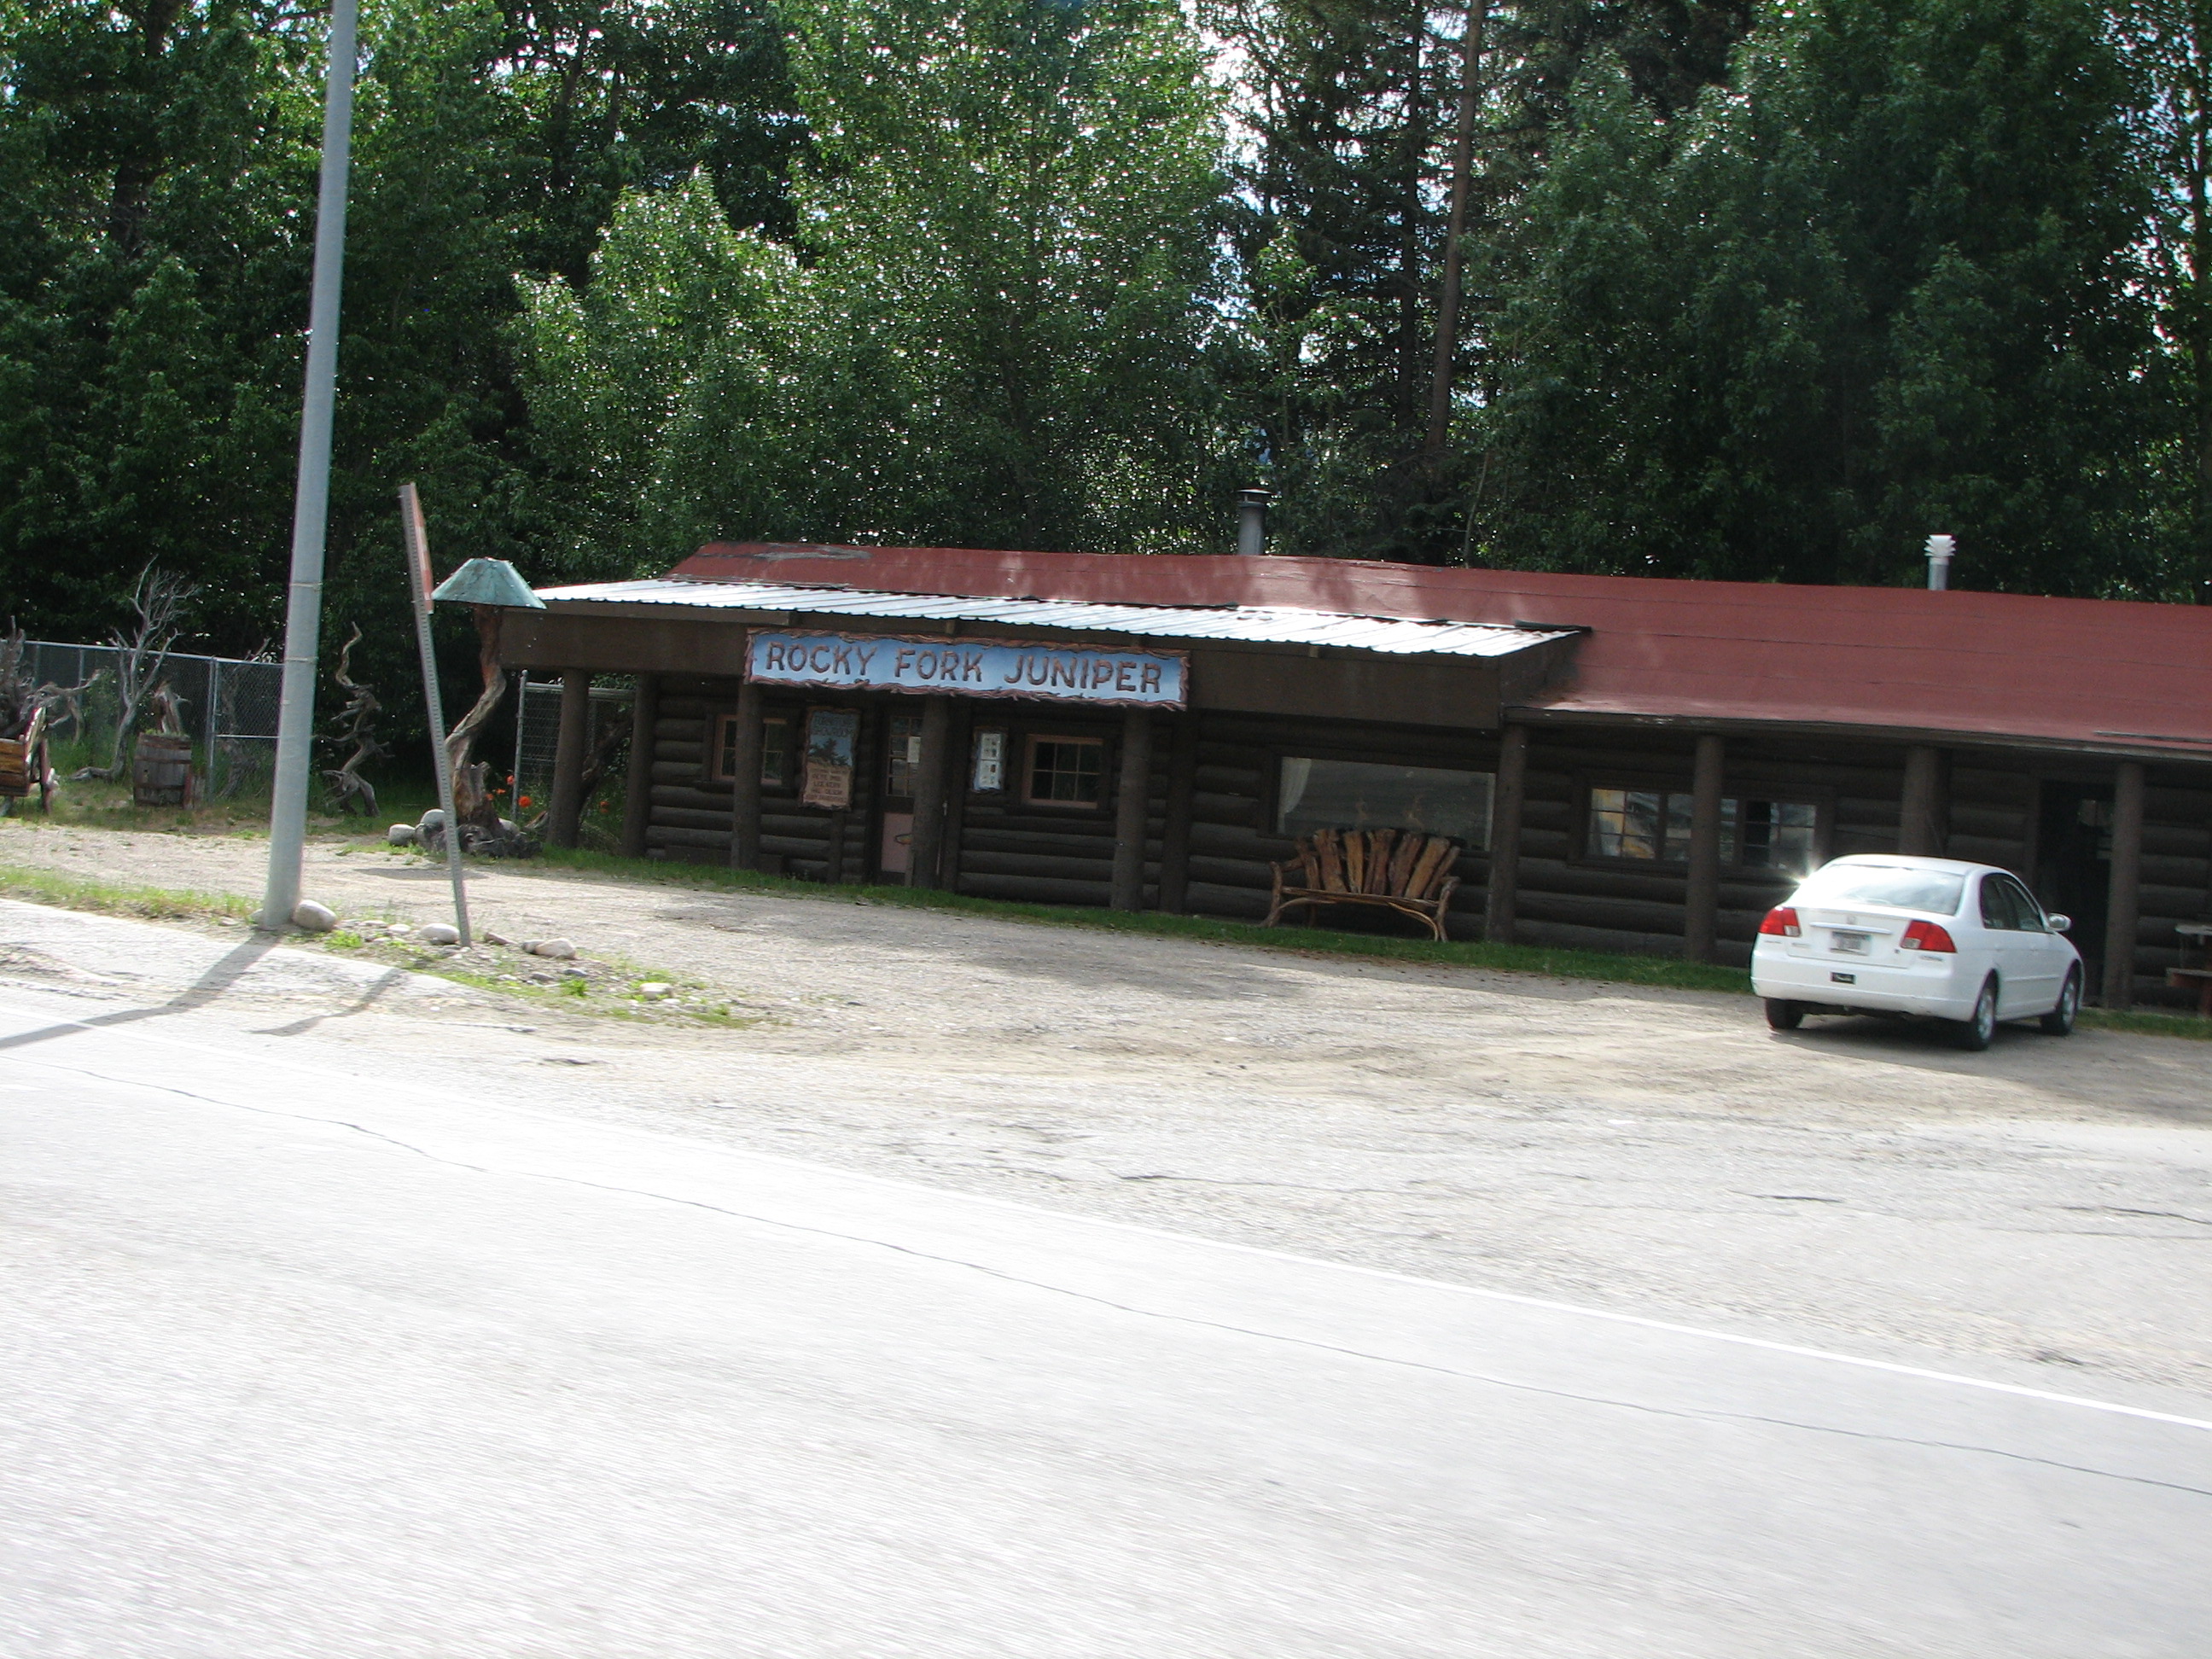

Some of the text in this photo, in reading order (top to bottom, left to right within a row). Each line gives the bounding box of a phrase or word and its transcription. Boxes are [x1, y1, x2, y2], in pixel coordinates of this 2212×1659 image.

[766, 642, 1161, 693] ROCKY FORK JUNIPER
